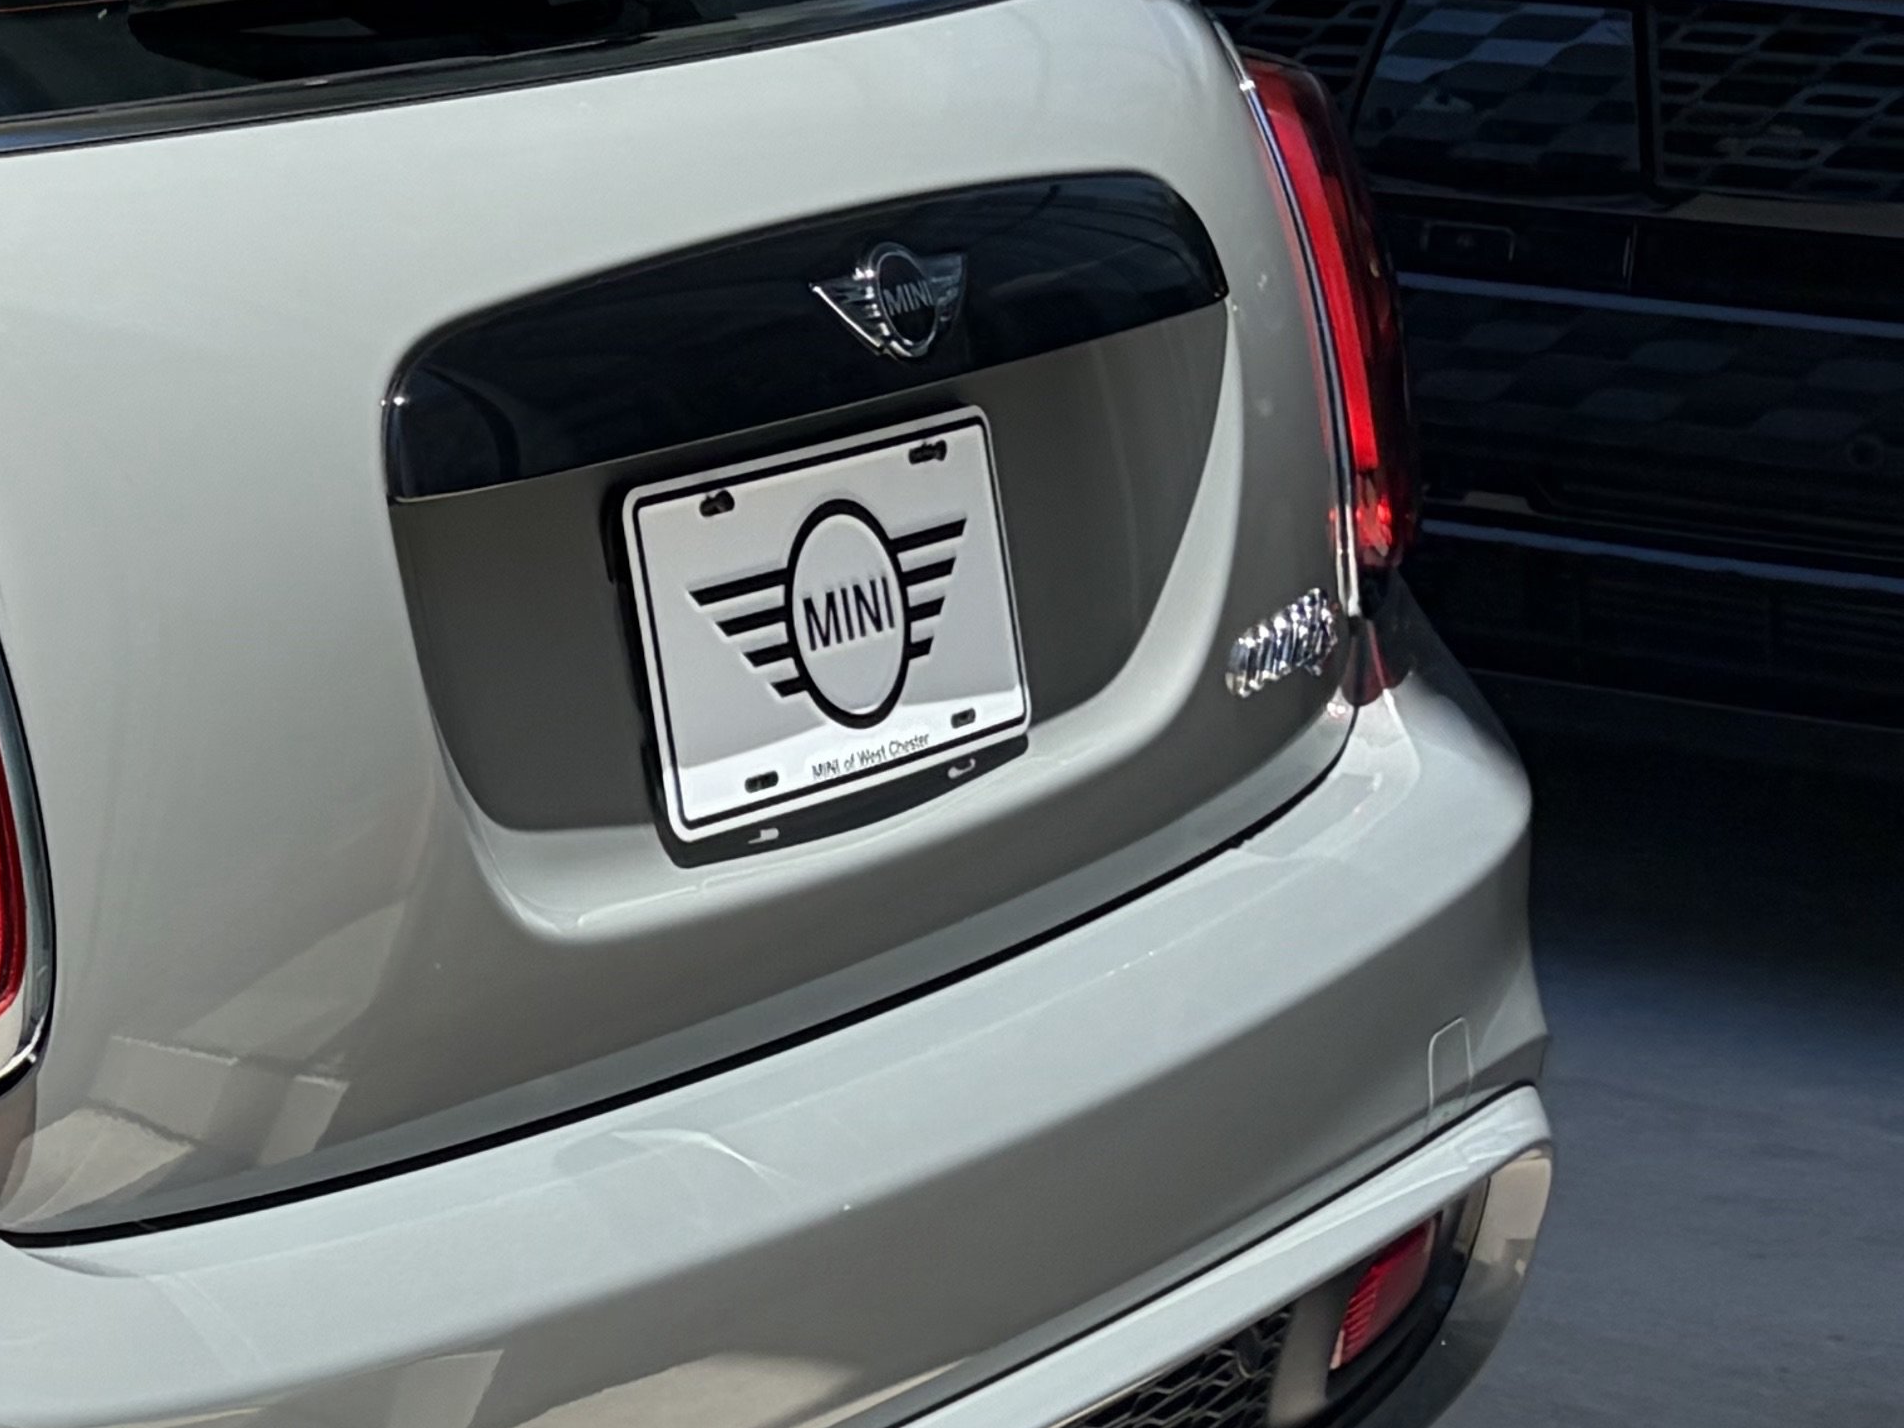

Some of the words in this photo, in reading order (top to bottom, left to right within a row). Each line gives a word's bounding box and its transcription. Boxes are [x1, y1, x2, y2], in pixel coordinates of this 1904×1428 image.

[882, 280, 934, 317] MINI
[802, 574, 895, 651] MINI
[811, 758, 840, 780] MINI
[843, 752, 855, 771] of
[856, 745, 887, 767] West
[888, 733, 930, 757] Chester
